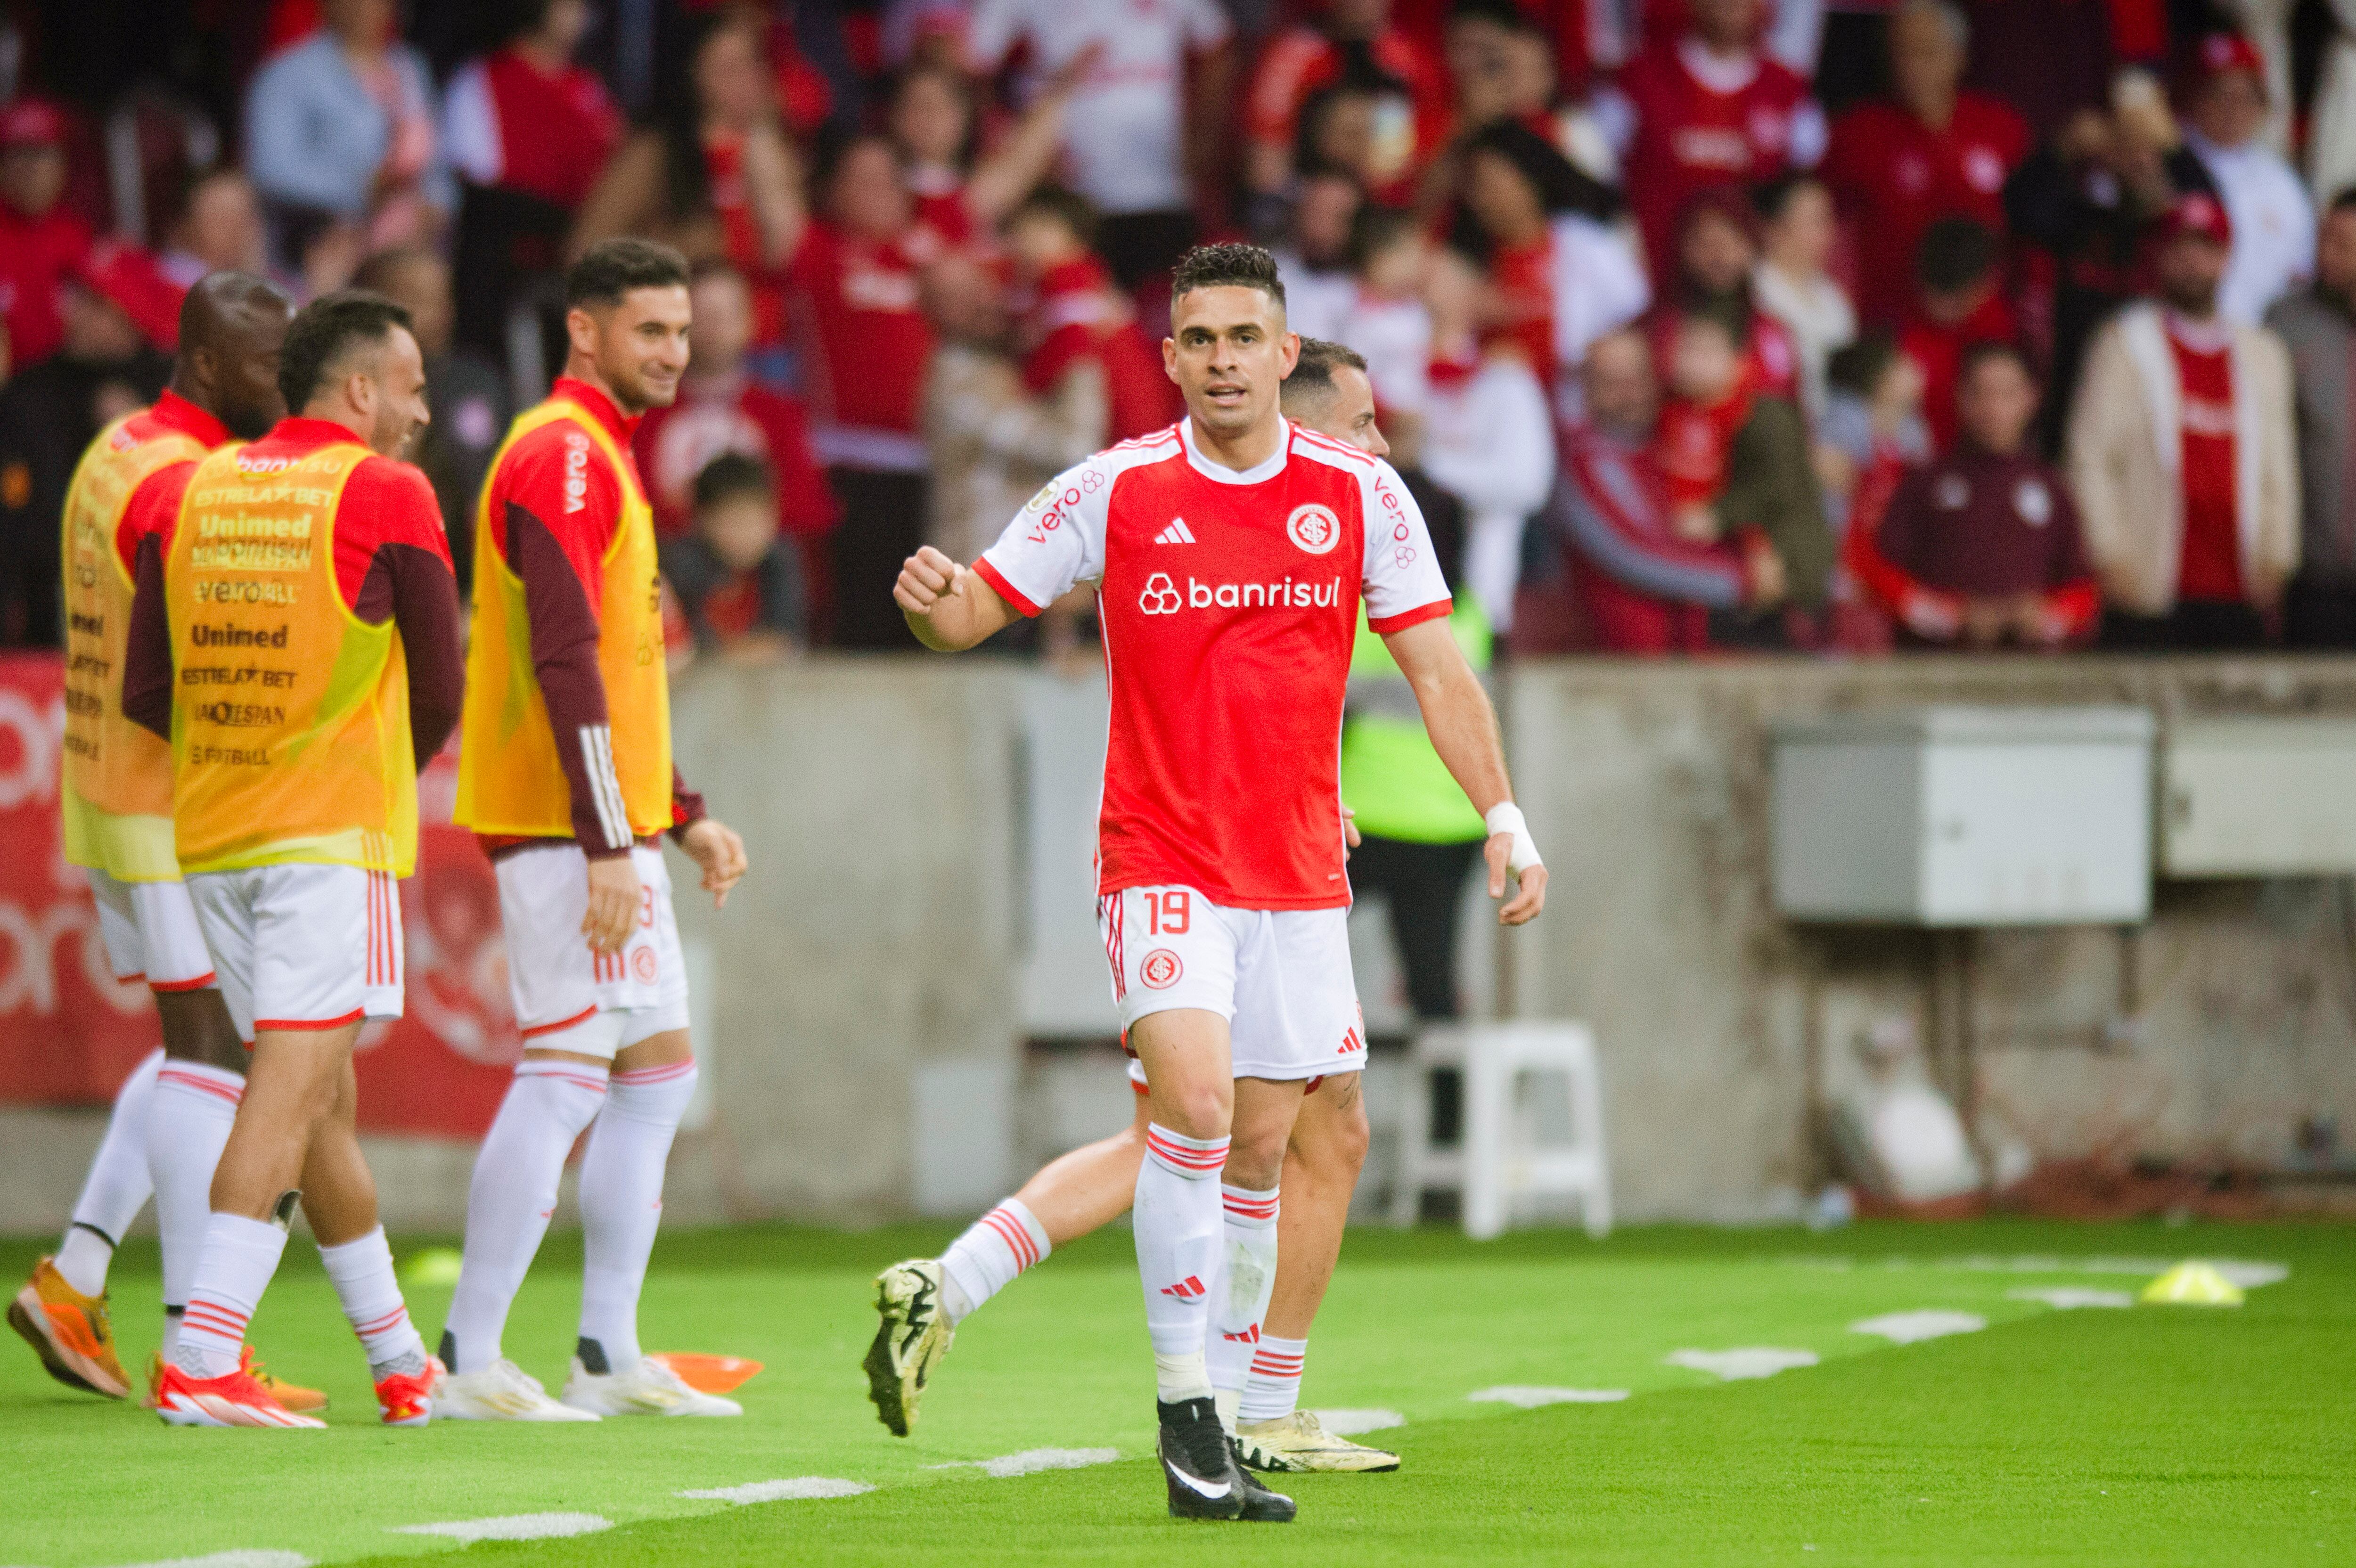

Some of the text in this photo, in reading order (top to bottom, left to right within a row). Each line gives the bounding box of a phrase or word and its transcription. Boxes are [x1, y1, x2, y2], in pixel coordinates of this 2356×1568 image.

[200, 512, 312, 539] Unimed
[1027, 488, 1081, 544] vero
[1375, 476, 1409, 541] vero
[1189, 576, 1341, 608] banrisul
[191, 622, 288, 648] Unimed
[1144, 891, 1190, 936] 19
